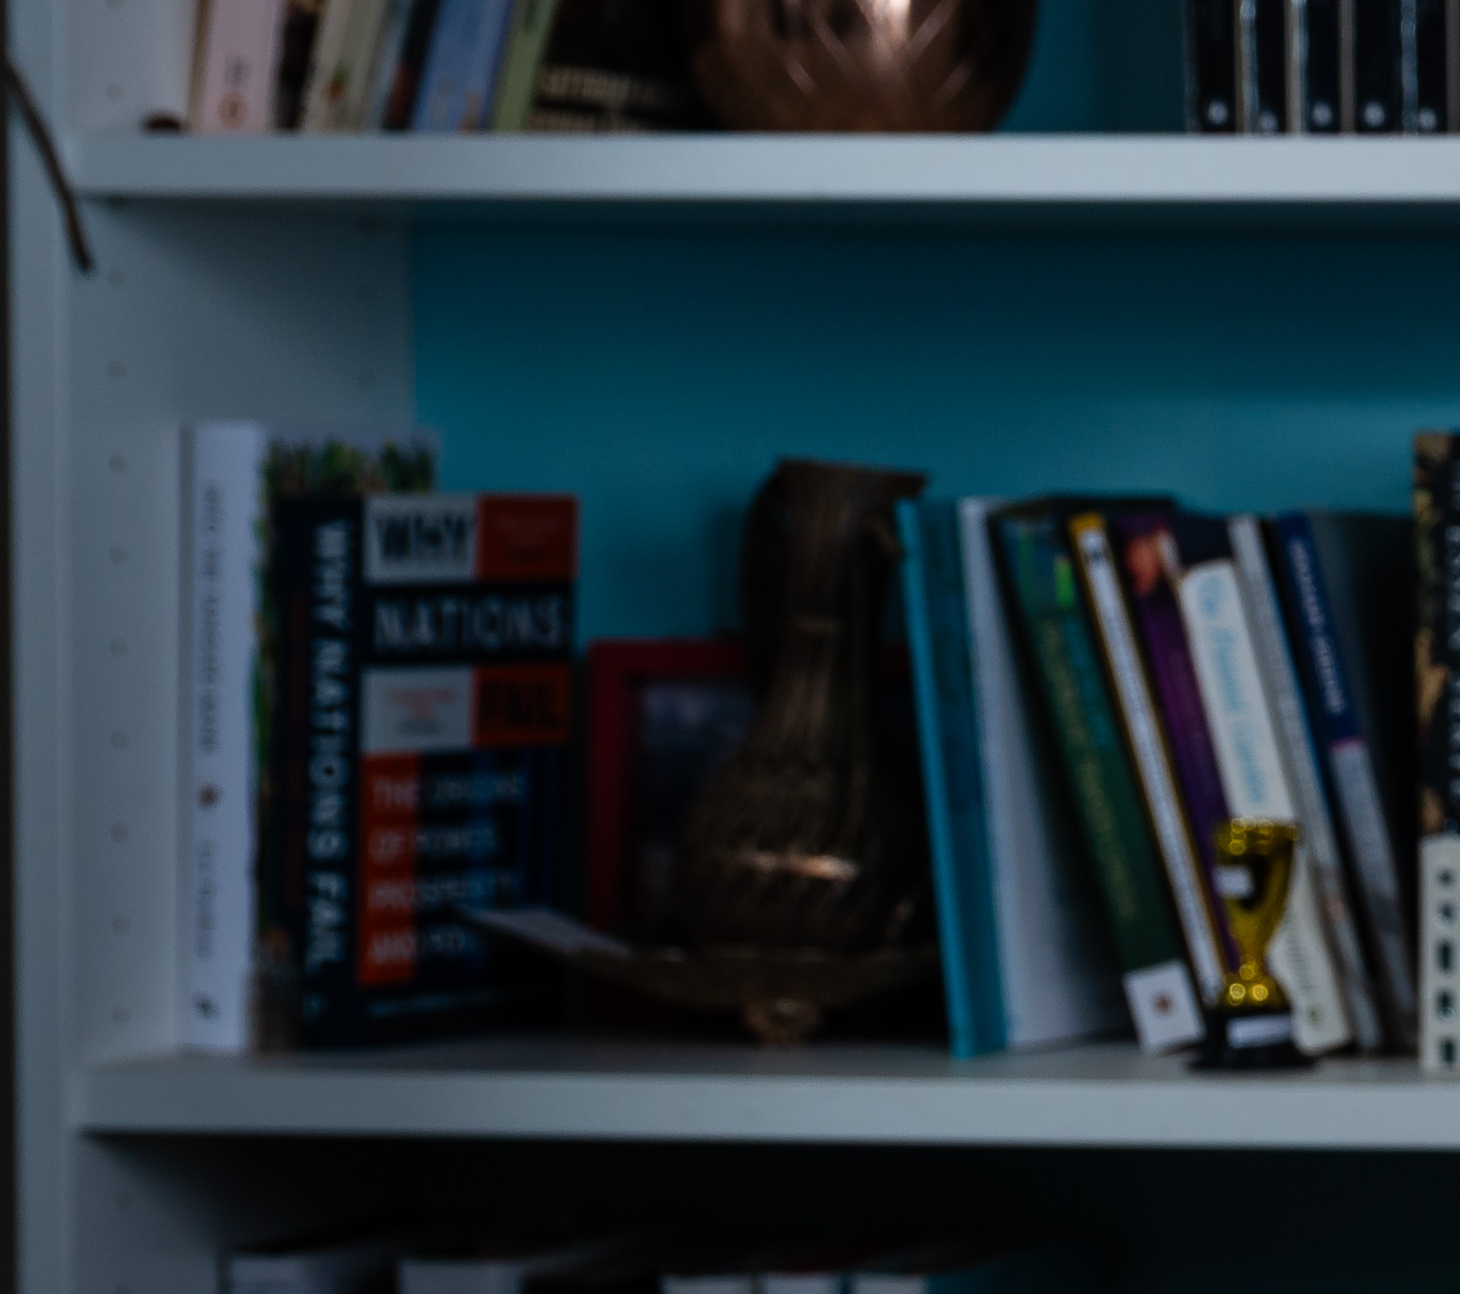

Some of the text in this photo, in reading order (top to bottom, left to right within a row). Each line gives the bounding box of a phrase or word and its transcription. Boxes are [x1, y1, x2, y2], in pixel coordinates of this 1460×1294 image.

[376, 511, 470, 565] WHY
[374, 593, 568, 657] NATIONS
[478, 678, 560, 733] FAIL
[302, 517, 354, 976] WHY NATIONS FAIL
